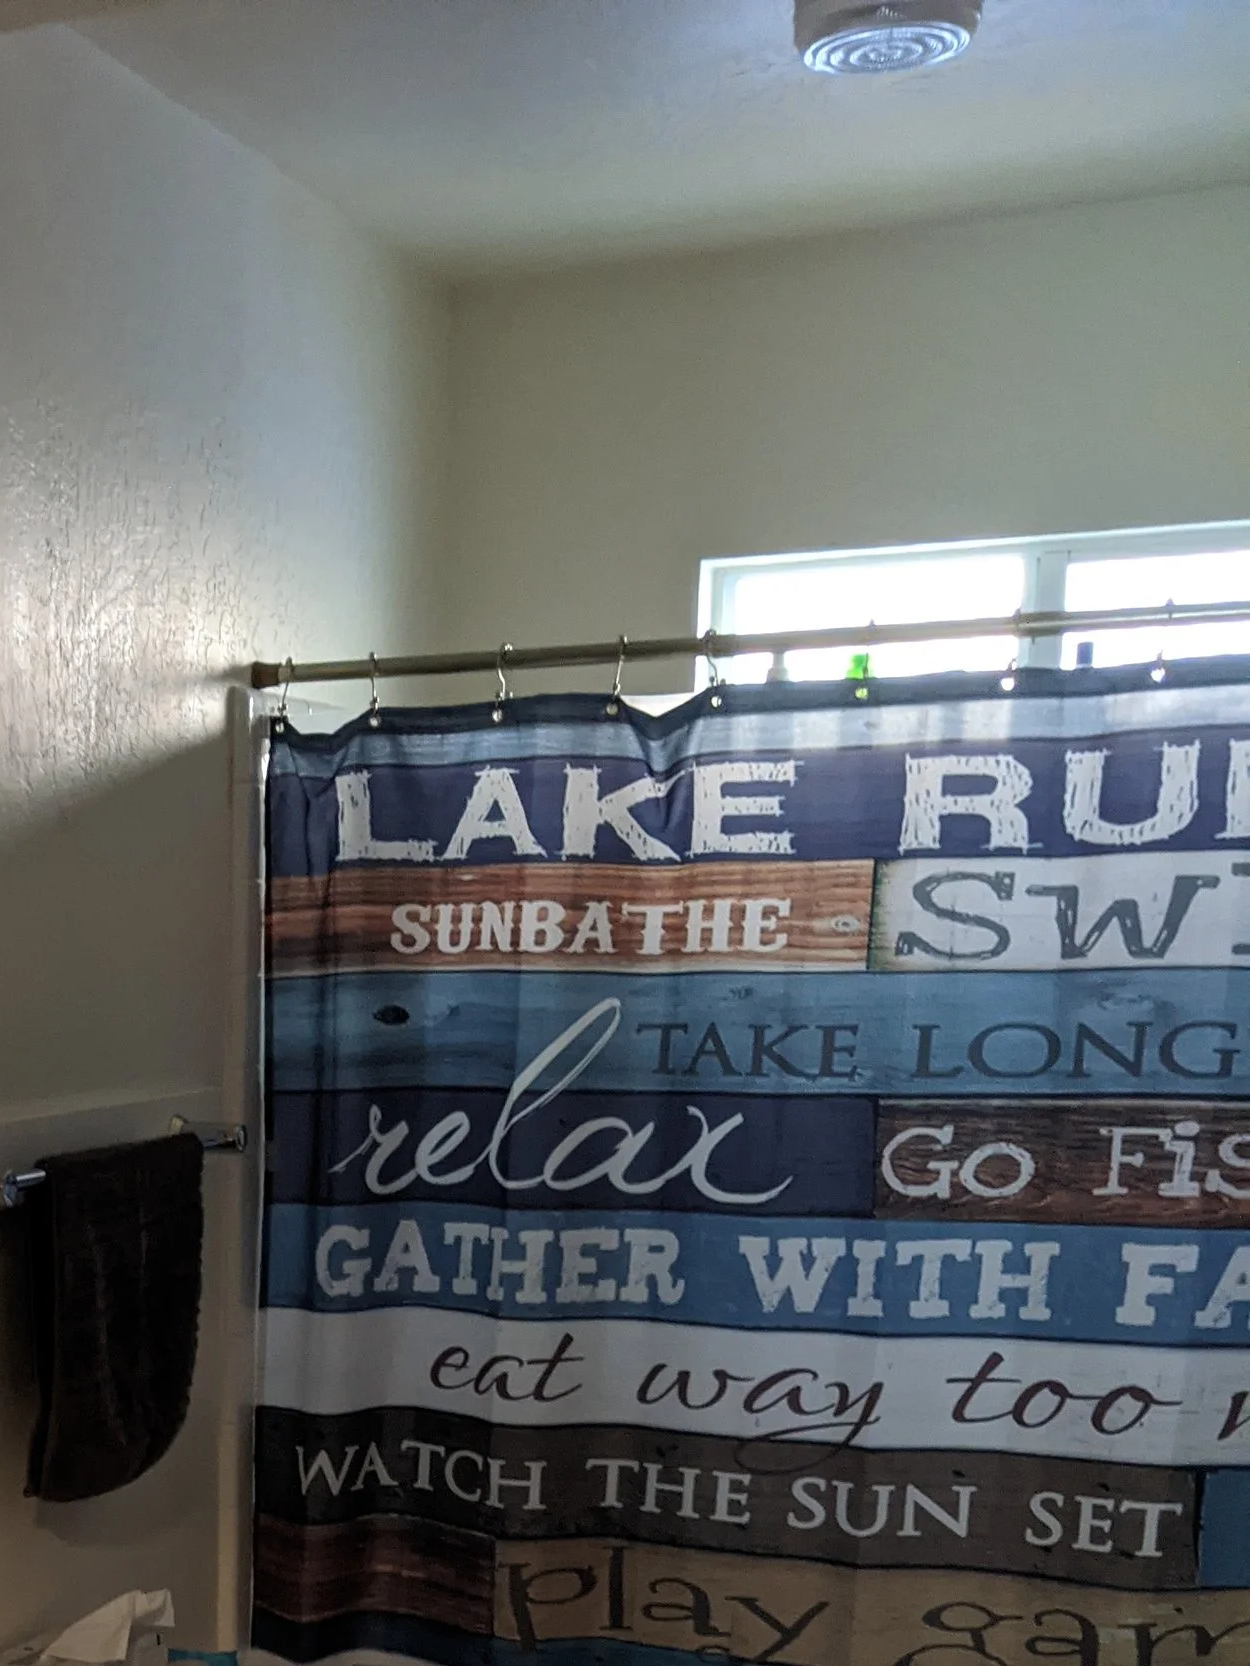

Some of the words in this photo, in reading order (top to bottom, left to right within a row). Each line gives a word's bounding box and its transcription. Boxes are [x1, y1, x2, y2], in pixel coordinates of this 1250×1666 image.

[333, 758, 805, 862] LAKE
[390, 897, 793, 955] SUNBATHE
[895, 862, 1250, 960] SW
[327, 997, 793, 1204] relax
[636, 1020, 860, 1079] TAKE
[881, 1123, 1036, 1199] Go
[314, 1219, 686, 1306] GATHER
[738, 1233, 1060, 1322] WITH
[430, 1331, 584, 1402] eat
[636, 1361, 885, 1474] way
[946, 1351, 1183, 1436] too
[296, 1438, 548, 1511] WATCH
[585, 1456, 752, 1526] THE
[786, 1475, 978, 1539] SUN
[1024, 1490, 1184, 1559] SET
[498, 1544, 832, 1664] play
